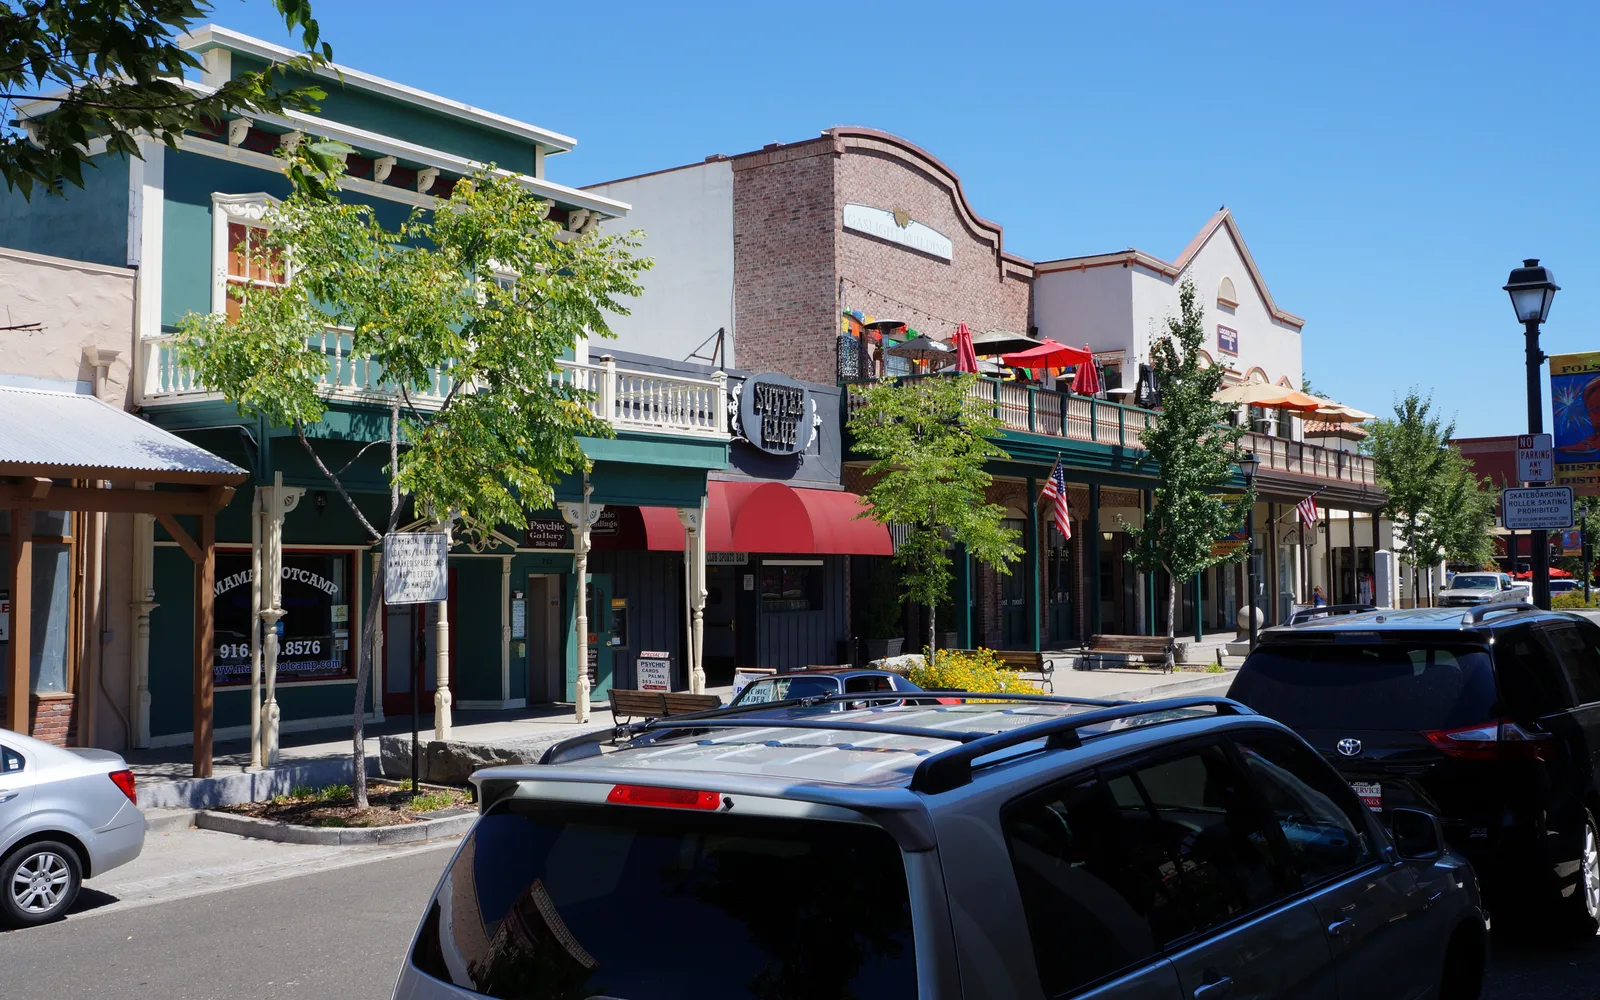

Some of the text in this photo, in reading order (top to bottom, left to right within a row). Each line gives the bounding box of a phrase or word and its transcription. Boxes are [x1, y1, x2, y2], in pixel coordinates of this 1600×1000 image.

[847, 214, 950, 257] GASLIGHT BUILDING
[1520, 437, 1532, 448] NO
[1521, 450, 1550, 459] PARKING
[1509, 491, 1567, 499] SKATEBOARDING
[1517, 506, 1559, 514] PROHIBITED
[530, 520, 565, 532] Psychic
[391, 537, 419, 545] COMMERCIAL
[529, 532, 564, 541] Gallery
[707, 552, 745, 562] CLUB SPORTS BAR
[411, 580, 431, 588] MINUTES
